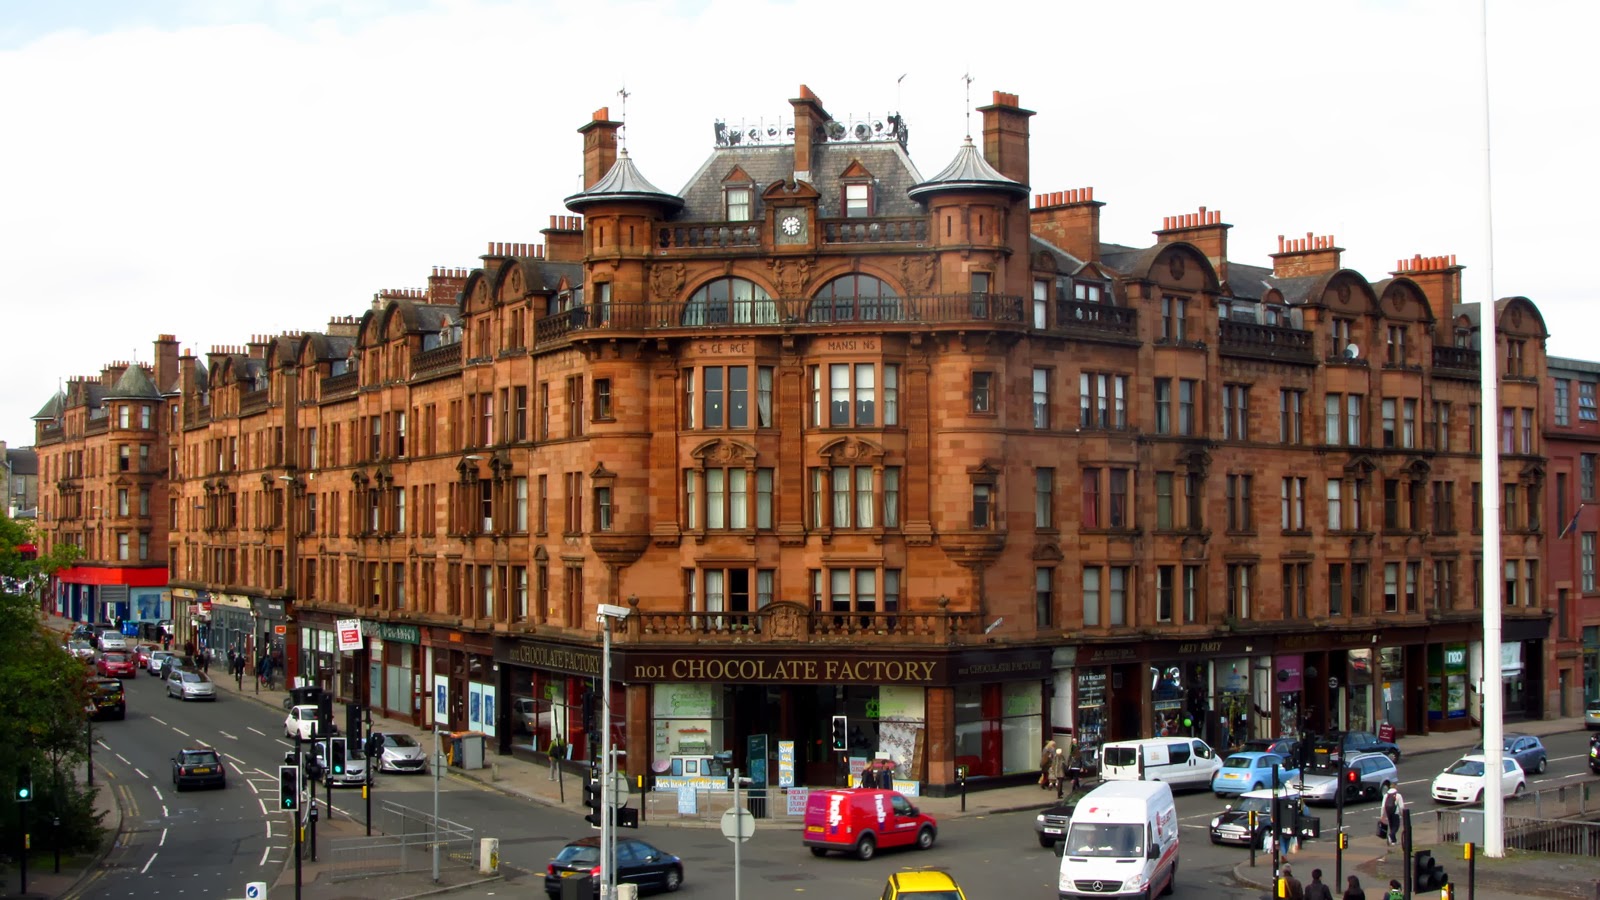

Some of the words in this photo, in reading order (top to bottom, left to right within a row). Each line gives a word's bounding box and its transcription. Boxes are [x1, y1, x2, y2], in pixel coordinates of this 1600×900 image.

[827, 339, 876, 351] MANSINS
[1199, 641, 1223, 652] PARTY
[519, 645, 564, 668] CHOCOLATE
[564, 651, 601, 674] FACTORY
[634, 665, 666, 679] no1
[671, 659, 819, 681] CHOCOLATE
[824, 660, 937, 682] FACTORY
